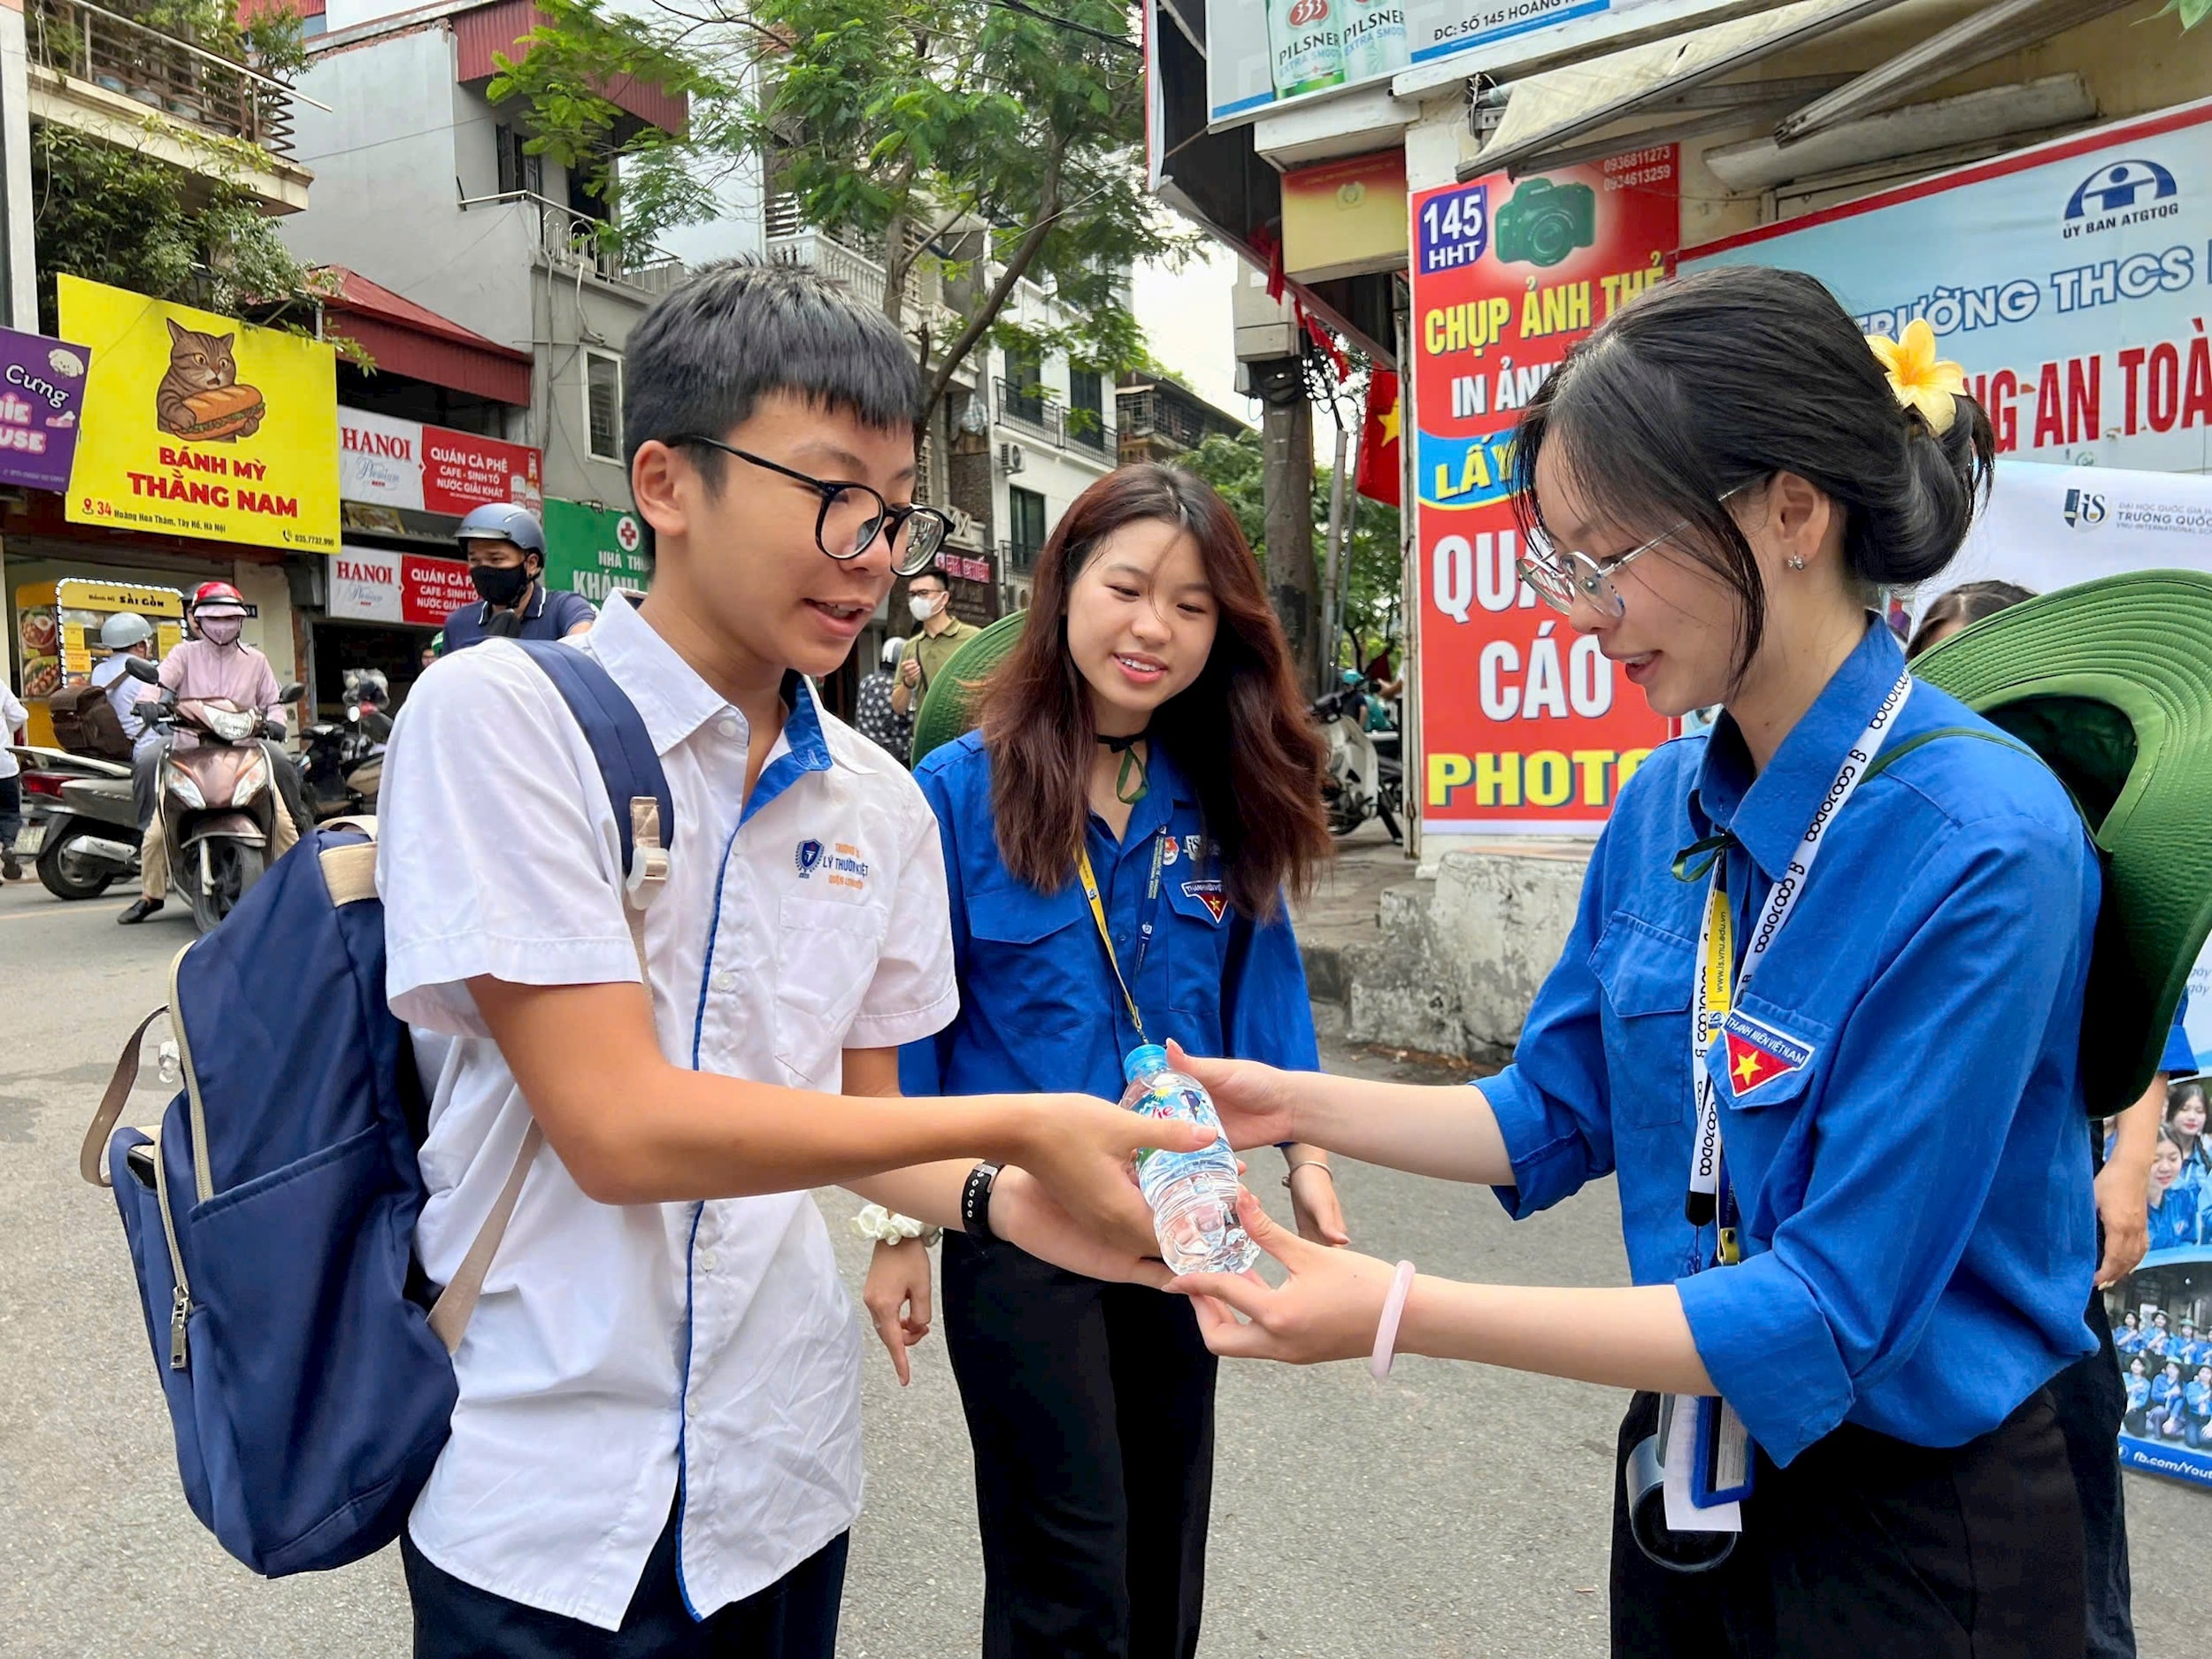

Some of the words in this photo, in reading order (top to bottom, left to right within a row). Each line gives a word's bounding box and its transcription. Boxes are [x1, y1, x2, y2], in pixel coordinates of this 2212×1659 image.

[1344, 10, 1405, 44] PILSNER
[1433, 26, 1457, 41] ĐC:
[1461, 12, 1480, 33] SỐ
[1484, 11, 1504, 27] 145
[1279, 32, 1340, 65] PILSNER
[1345, 34, 1373, 56] EXTRA
[1603, 145, 1671, 173] 0936811273
[1603, 164, 1671, 192] 0934613259
[1423, 194, 1483, 244] 145
[2086, 218, 2116, 234] BAN
[2122, 203, 2178, 227] ATGTQG
[1428, 240, 1480, 270] HHT
[2050, 244, 2194, 313] THCS
[1425, 297, 1510, 357] CHỤP
[1519, 276, 1591, 339] ẢNH
[5, 364, 70, 409] Cưng
[1451, 374, 1486, 418] IN
[2033, 355, 2101, 448] AN
[342, 426, 411, 462] HANOI
[159, 445, 227, 476] BÁNH
[234, 457, 267, 481] MỲ
[431, 447, 465, 466] QUÁN
[468, 452, 485, 469] CÀ
[486, 457, 509, 474] PHÊ
[440, 465, 462, 479] CAFE
[467, 469, 488, 482] SINH
[488, 472, 501, 486] TỐ
[127, 469, 230, 508] THẰNG
[237, 489, 298, 518] NAM
[436, 477, 464, 492] NƯỚC
[481, 485, 504, 498] KHÁT
[96, 501, 111, 516] 34
[114, 509, 138, 521] Hoàng
[139, 514, 153, 523] Hoa
[204, 522, 213, 531] Hà
[214, 523, 227, 534] Nội
[336, 560, 394, 585] HANOI
[411, 568, 446, 584] QUÁN
[448, 571, 464, 587] CÀ
[119, 588, 139, 605] SÀI
[142, 594, 165, 608] GÒN
[417, 596, 442, 610] NƯỚC
[419, 584, 442, 597] CAFE
[447, 588, 467, 601] SINH
[1479, 621, 1612, 722] CÁO
[1727, 1018, 1753, 1036] THANH
[1750, 1030, 1770, 1046] NIÊN
[1781, 1044, 1806, 1064] NAM
